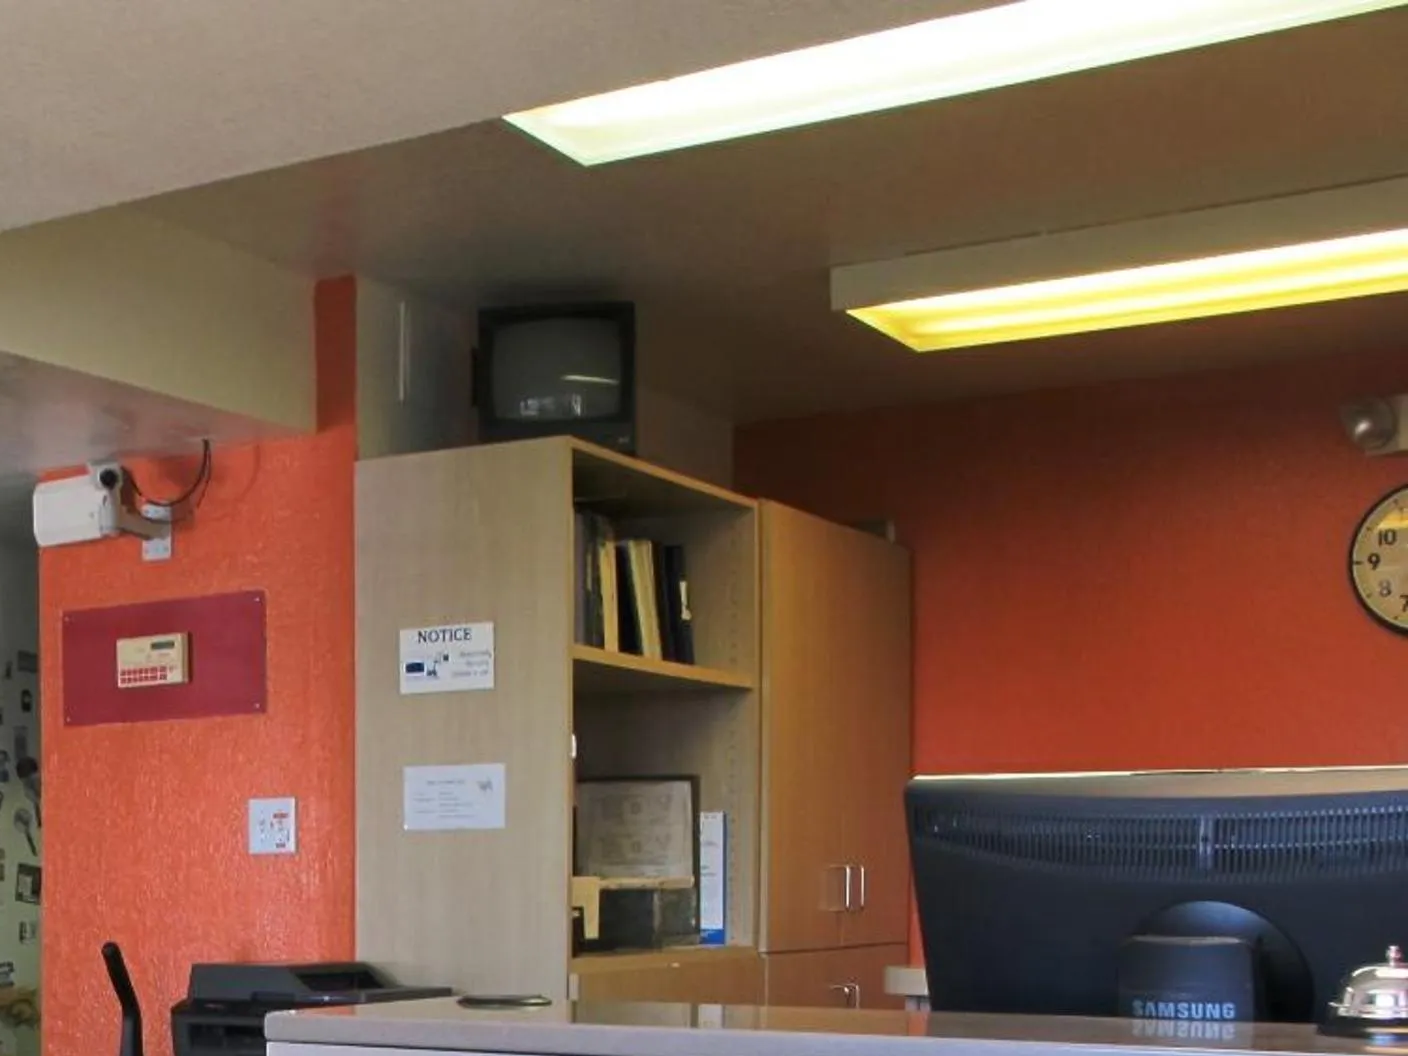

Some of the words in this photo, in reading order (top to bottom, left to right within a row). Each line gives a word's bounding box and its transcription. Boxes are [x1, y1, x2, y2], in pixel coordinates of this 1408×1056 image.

[1378, 528, 1396, 547] 10
[1367, 552, 1380, 570] 9
[1379, 579, 1392, 598] 8
[417, 627, 472, 643] NOTICE
[1132, 999, 1235, 1019] SAMSUNG
